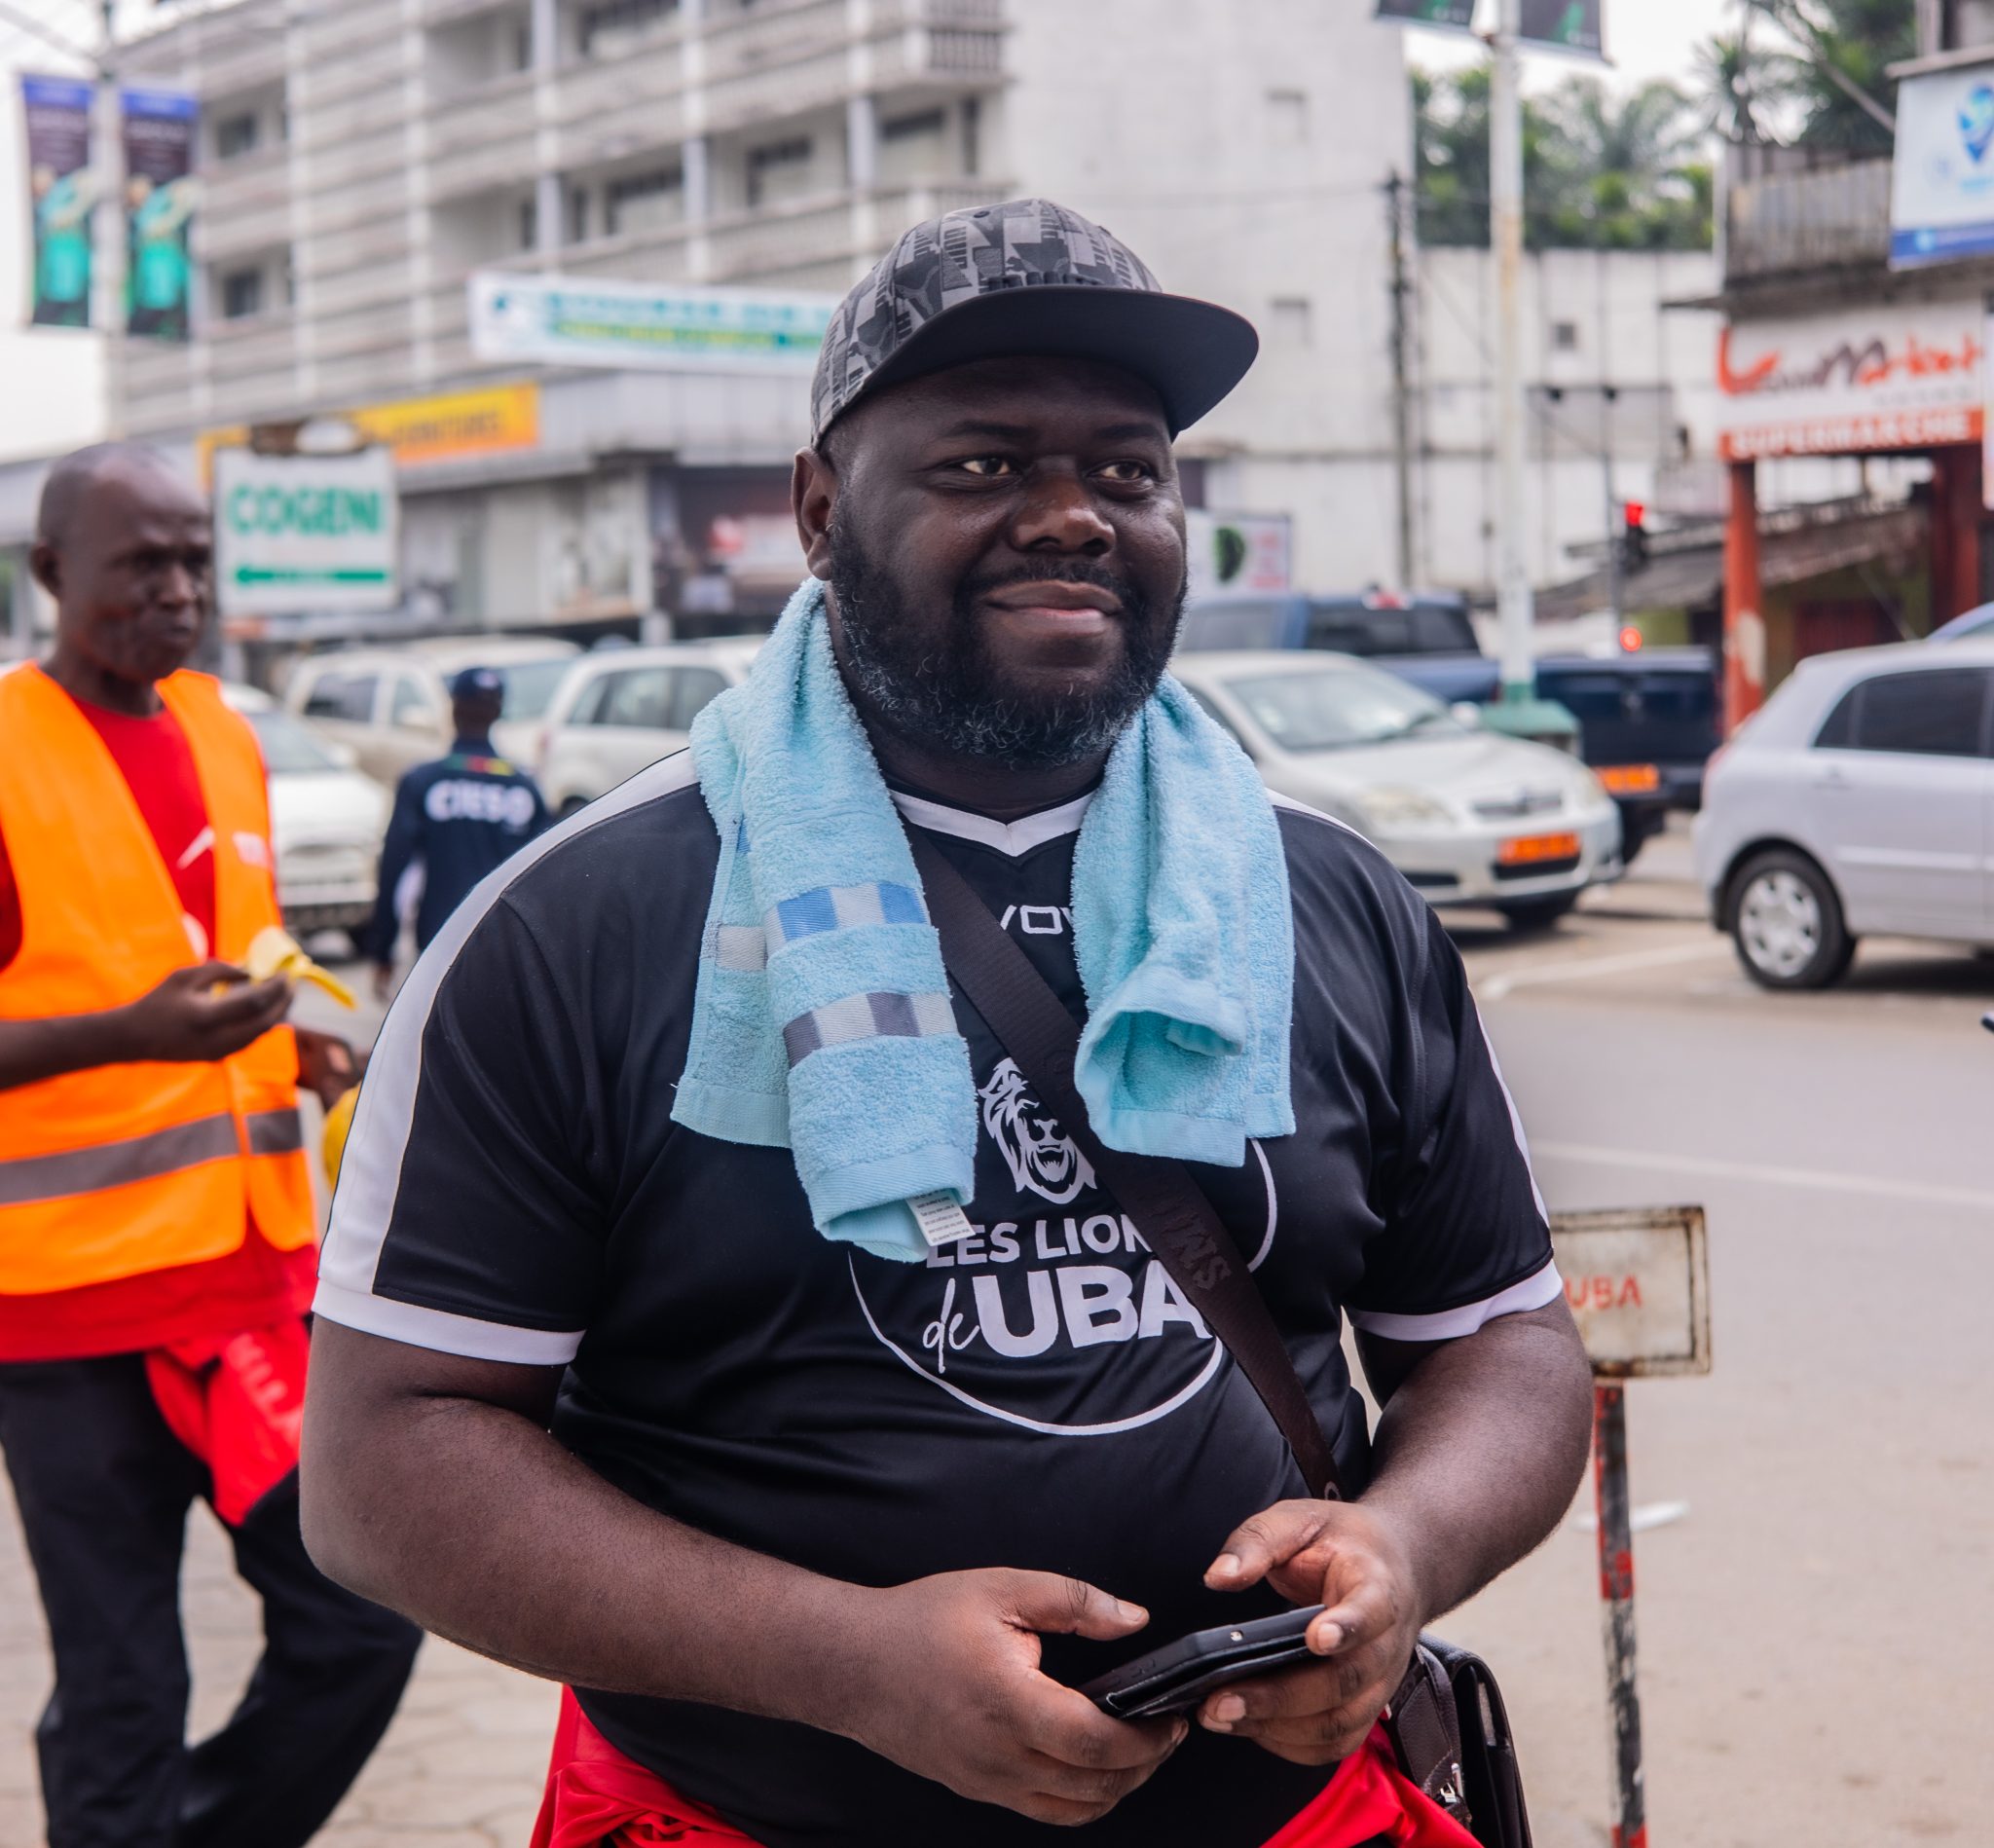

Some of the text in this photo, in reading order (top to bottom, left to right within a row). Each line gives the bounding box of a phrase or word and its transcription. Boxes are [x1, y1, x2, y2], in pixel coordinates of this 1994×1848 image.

[926, 1223, 1020, 1268] LES
[1564, 1275, 1643, 1310] UBA
[923, 1259, 1213, 1374] de UBA
